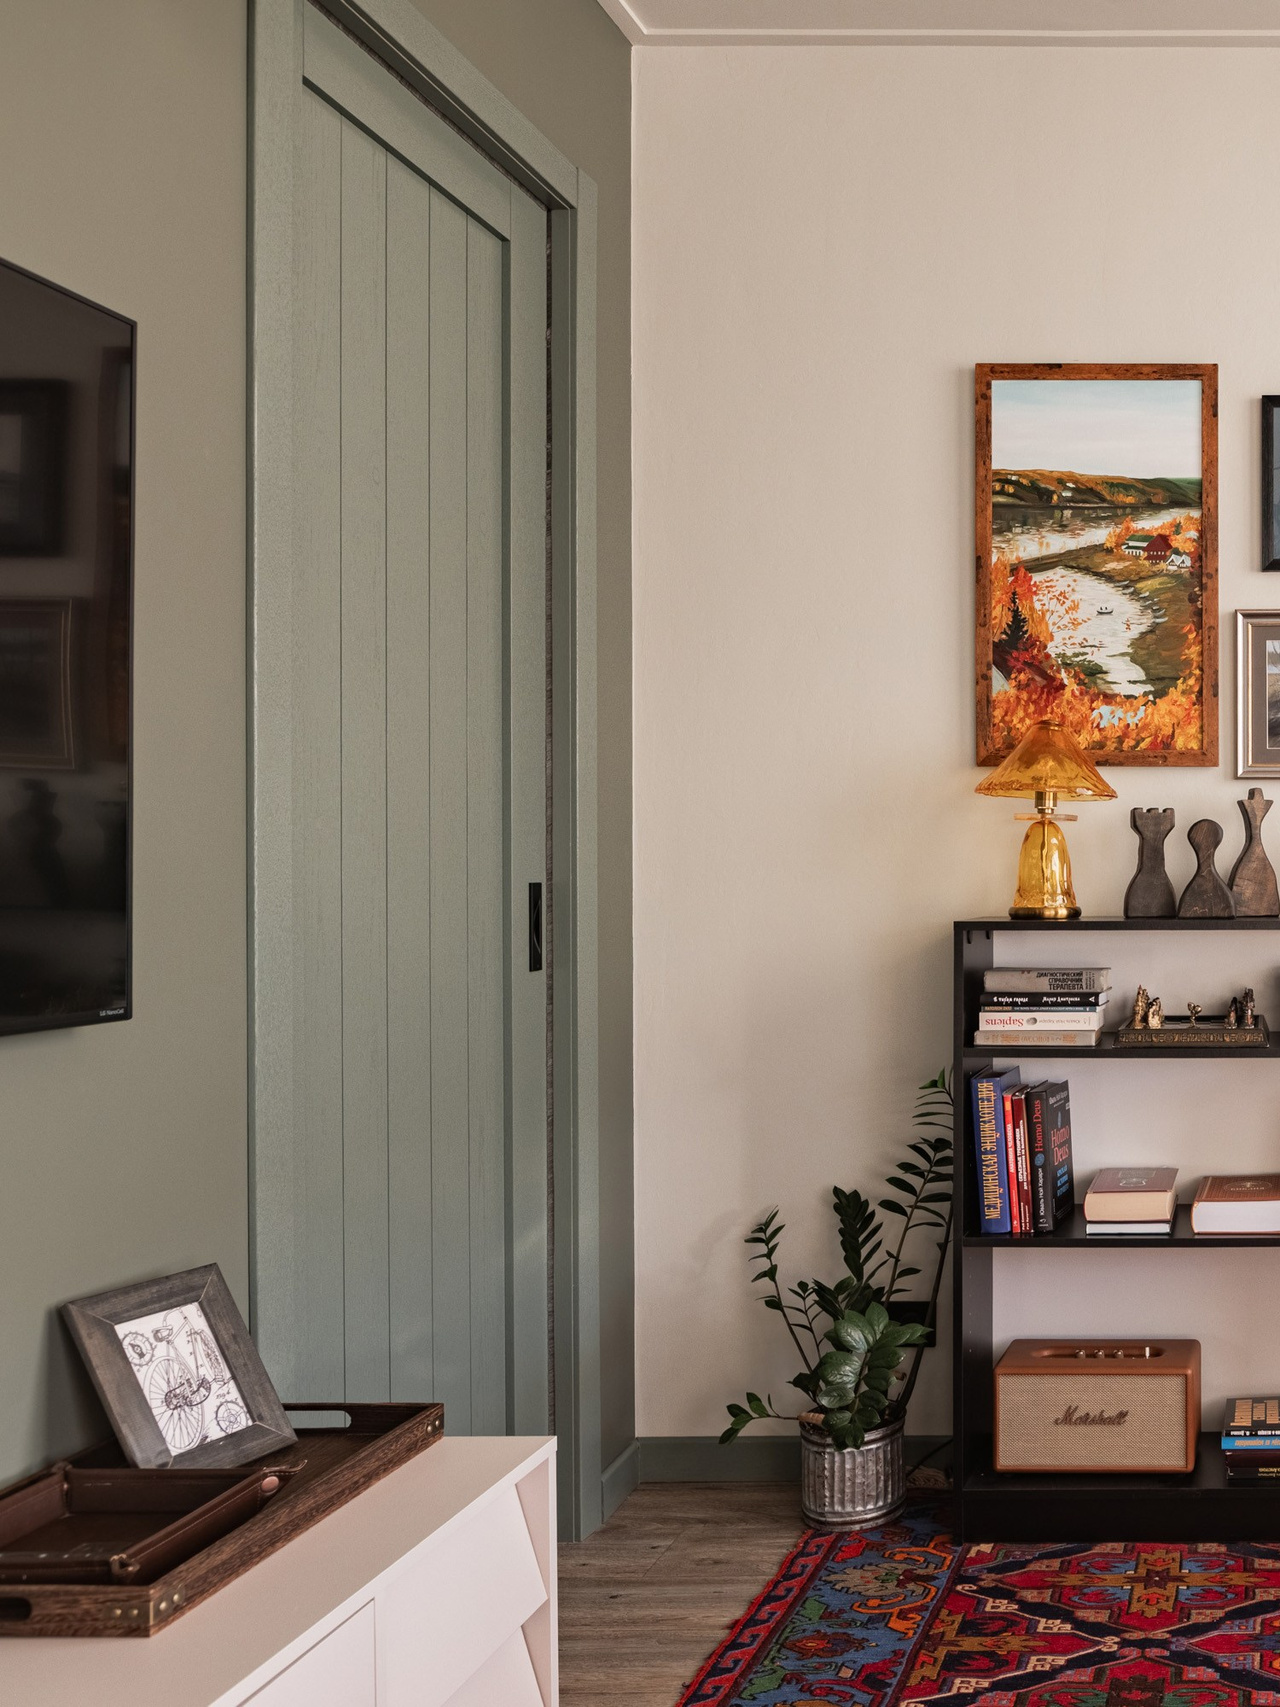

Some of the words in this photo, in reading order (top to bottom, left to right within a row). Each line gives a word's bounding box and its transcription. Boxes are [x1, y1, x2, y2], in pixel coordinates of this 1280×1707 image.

[985, 1016, 1024, 1028] Sapiens
[978, 1083, 1001, 1152] ЭНЦИКЛОПЕДИЯ
[1033, 1099, 1042, 1122] Deus
[1034, 1124, 1043, 1152] Homo
[1051, 1125, 1070, 1149] Homo
[1054, 1143, 1069, 1166] Deus
[982, 1154, 1004, 1220] МЕДИЦИНСКАЯ
[1054, 1405, 1129, 1425] Marshall
